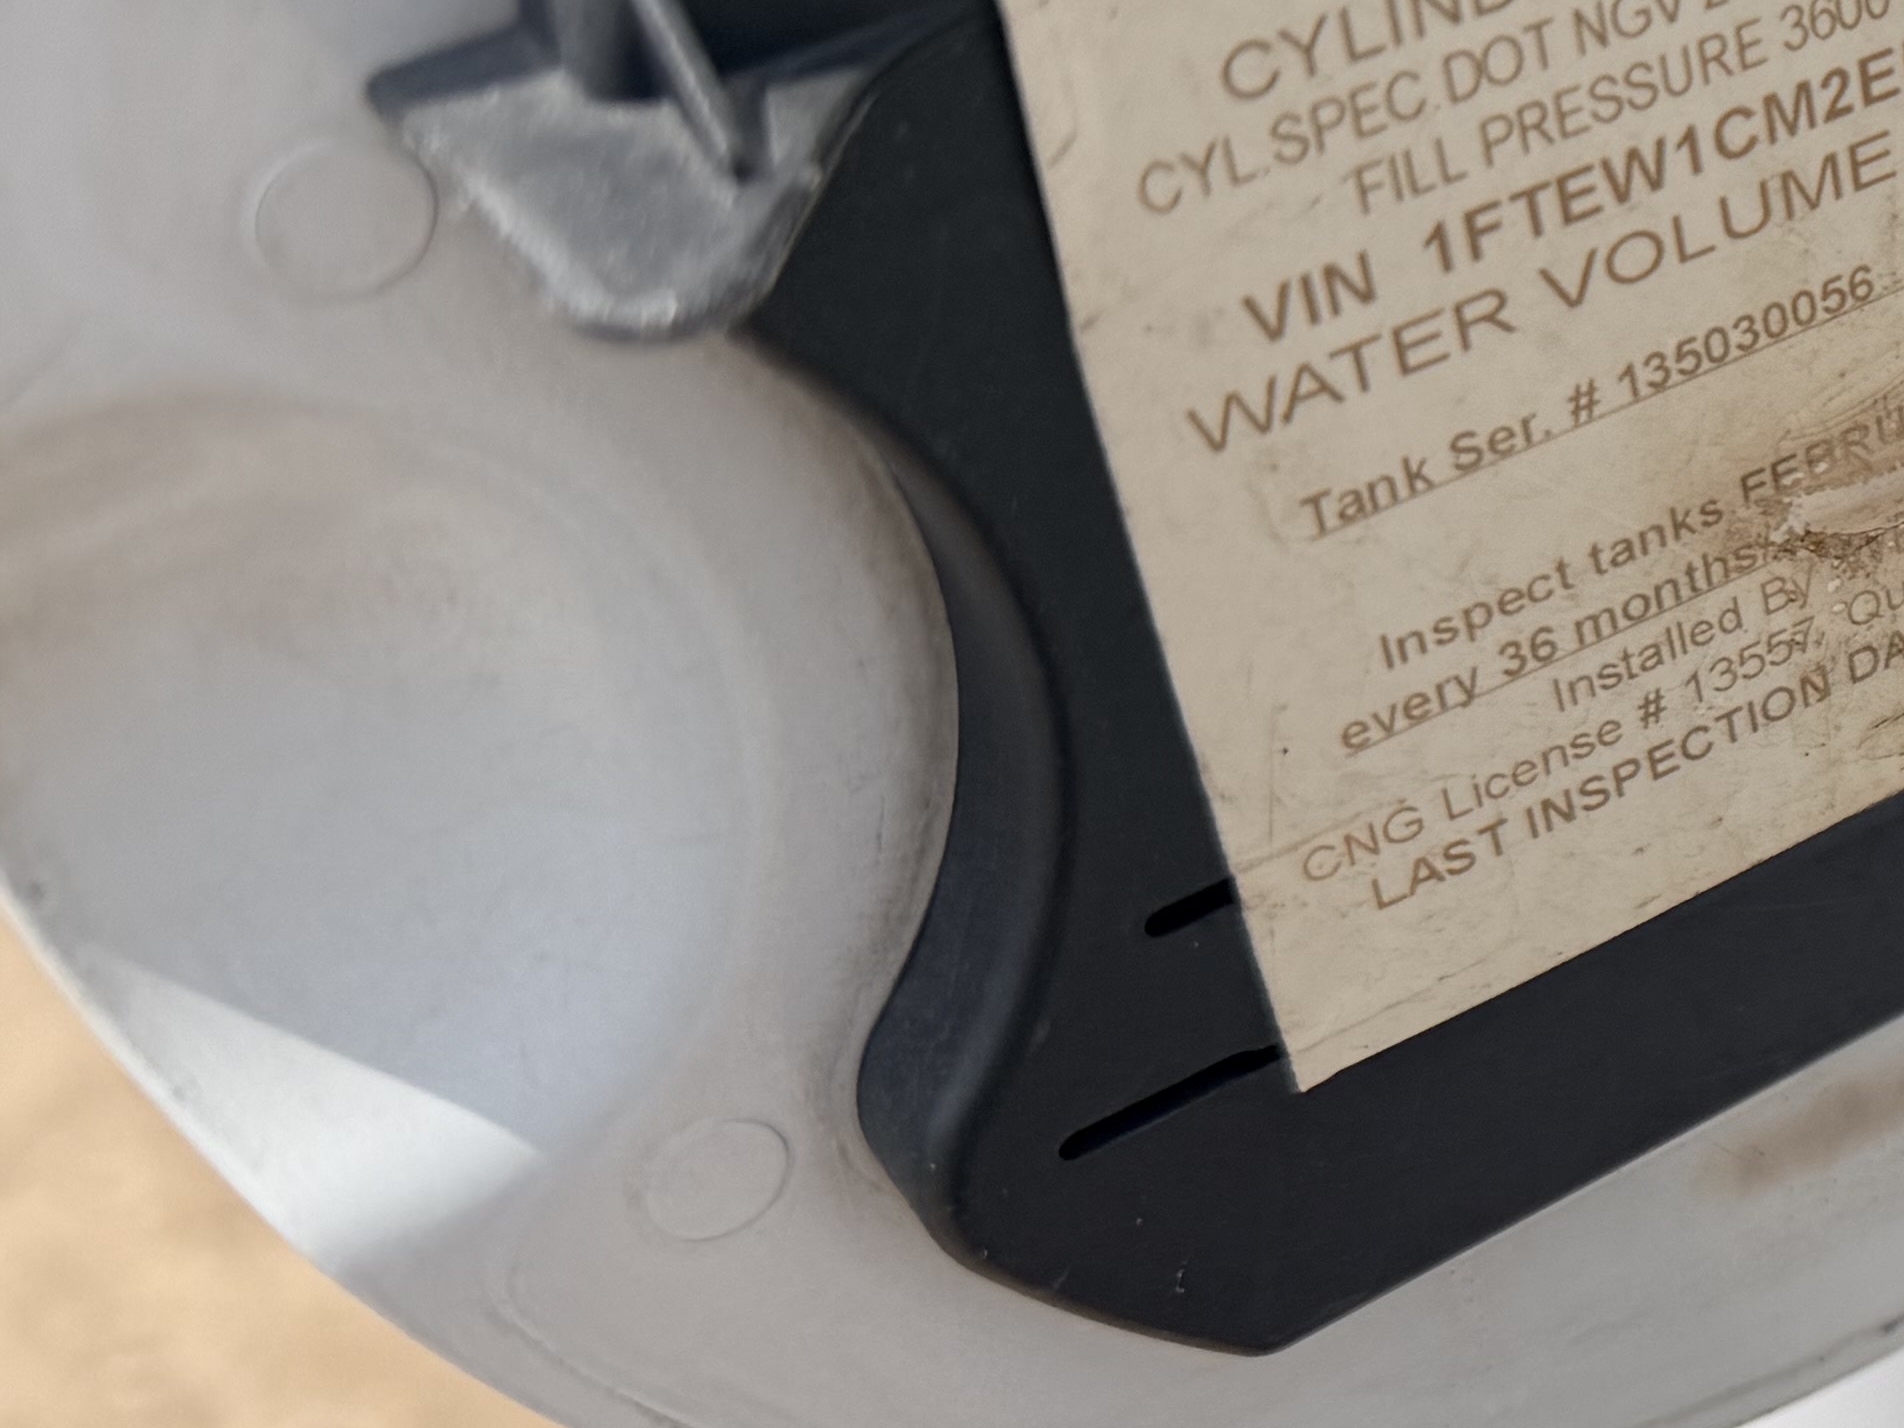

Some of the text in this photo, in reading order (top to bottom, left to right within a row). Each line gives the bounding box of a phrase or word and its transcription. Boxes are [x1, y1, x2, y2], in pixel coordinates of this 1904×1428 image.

[1351, 137, 1467, 216] FILL
[1480, 18, 1769, 169] PRESSURE
[1442, 17, 1554, 105] DOT
[1187, 288, 1515, 454] WATER
[1538, 130, 1898, 308] VOLUME
[1241, 250, 1376, 343] VIN
[1300, 455, 1435, 539] Tank
[1449, 410, 1553, 472] Ser.
[1567, 378, 1601, 427] #
[1618, 264, 1874, 401] 135030056
[1379, 557, 1575, 670] Inspect
[1588, 499, 1723, 575] tanks
[1553, 596, 1744, 713] Installed
[1761, 562, 1813, 615] By
[1340, 666, 1479, 752] every
[1498, 627, 1559, 679] 36
[1301, 805, 1426, 883] CNG
[1441, 719, 1623, 822] License
[1637, 689, 1669, 729] #
[1370, 817, 1508, 911] LAST
[1525, 662, 1832, 840] INSPECTION
